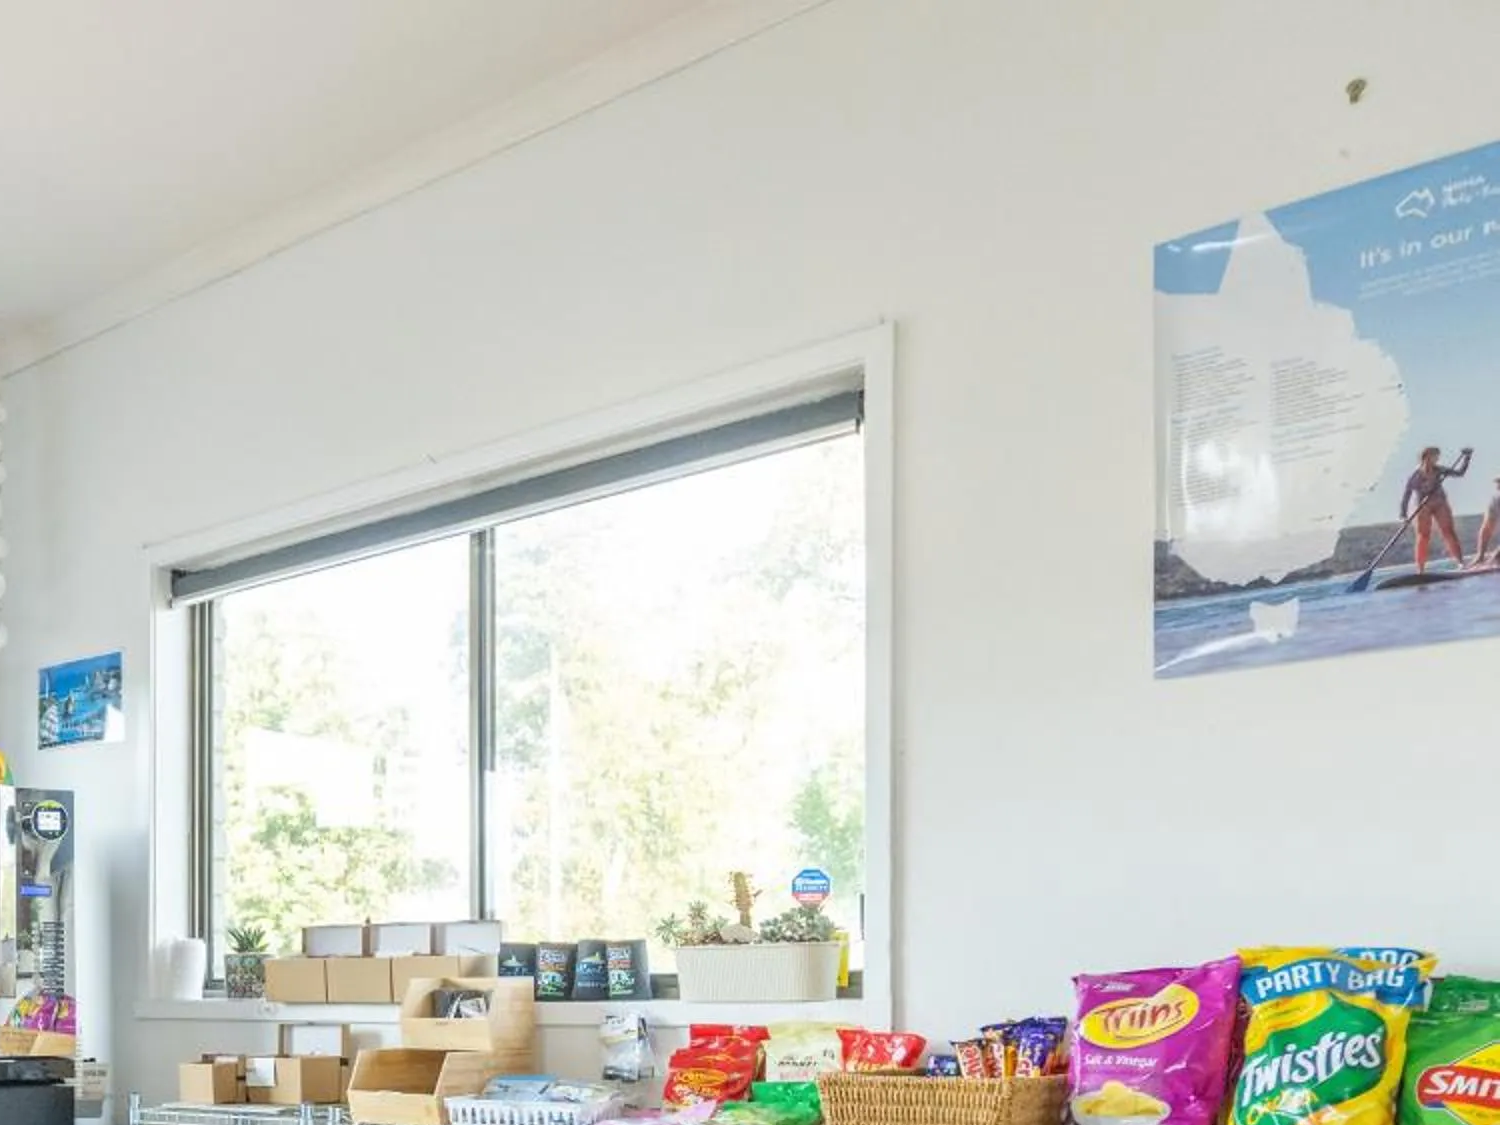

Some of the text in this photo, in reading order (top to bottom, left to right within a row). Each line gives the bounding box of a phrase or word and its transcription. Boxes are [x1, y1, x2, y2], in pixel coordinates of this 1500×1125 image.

[1360, 246, 1392, 269] It's
[1400, 238, 1421, 257] in
[1430, 226, 1473, 249] our
[1255, 961, 1341, 999] PARTY
[1097, 1000, 1188, 1034] Thins
[1241, 1026, 1386, 1108] Twisties
